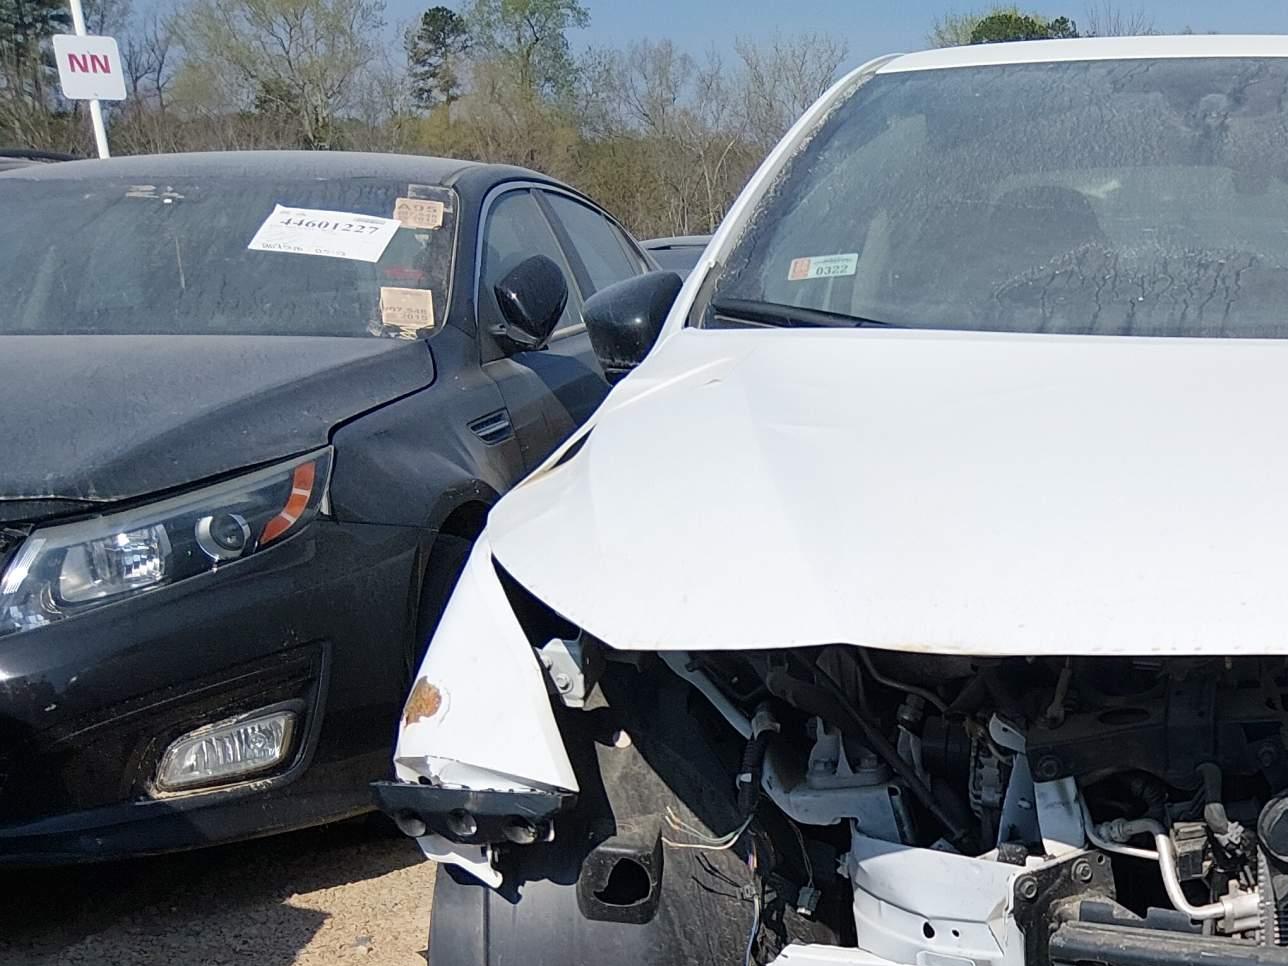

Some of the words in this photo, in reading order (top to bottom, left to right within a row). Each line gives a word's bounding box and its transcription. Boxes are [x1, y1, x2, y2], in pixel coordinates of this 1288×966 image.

[68, 53, 111, 74] NN
[280, 217, 380, 235] 44601227
[816, 264, 849, 276] 0322
